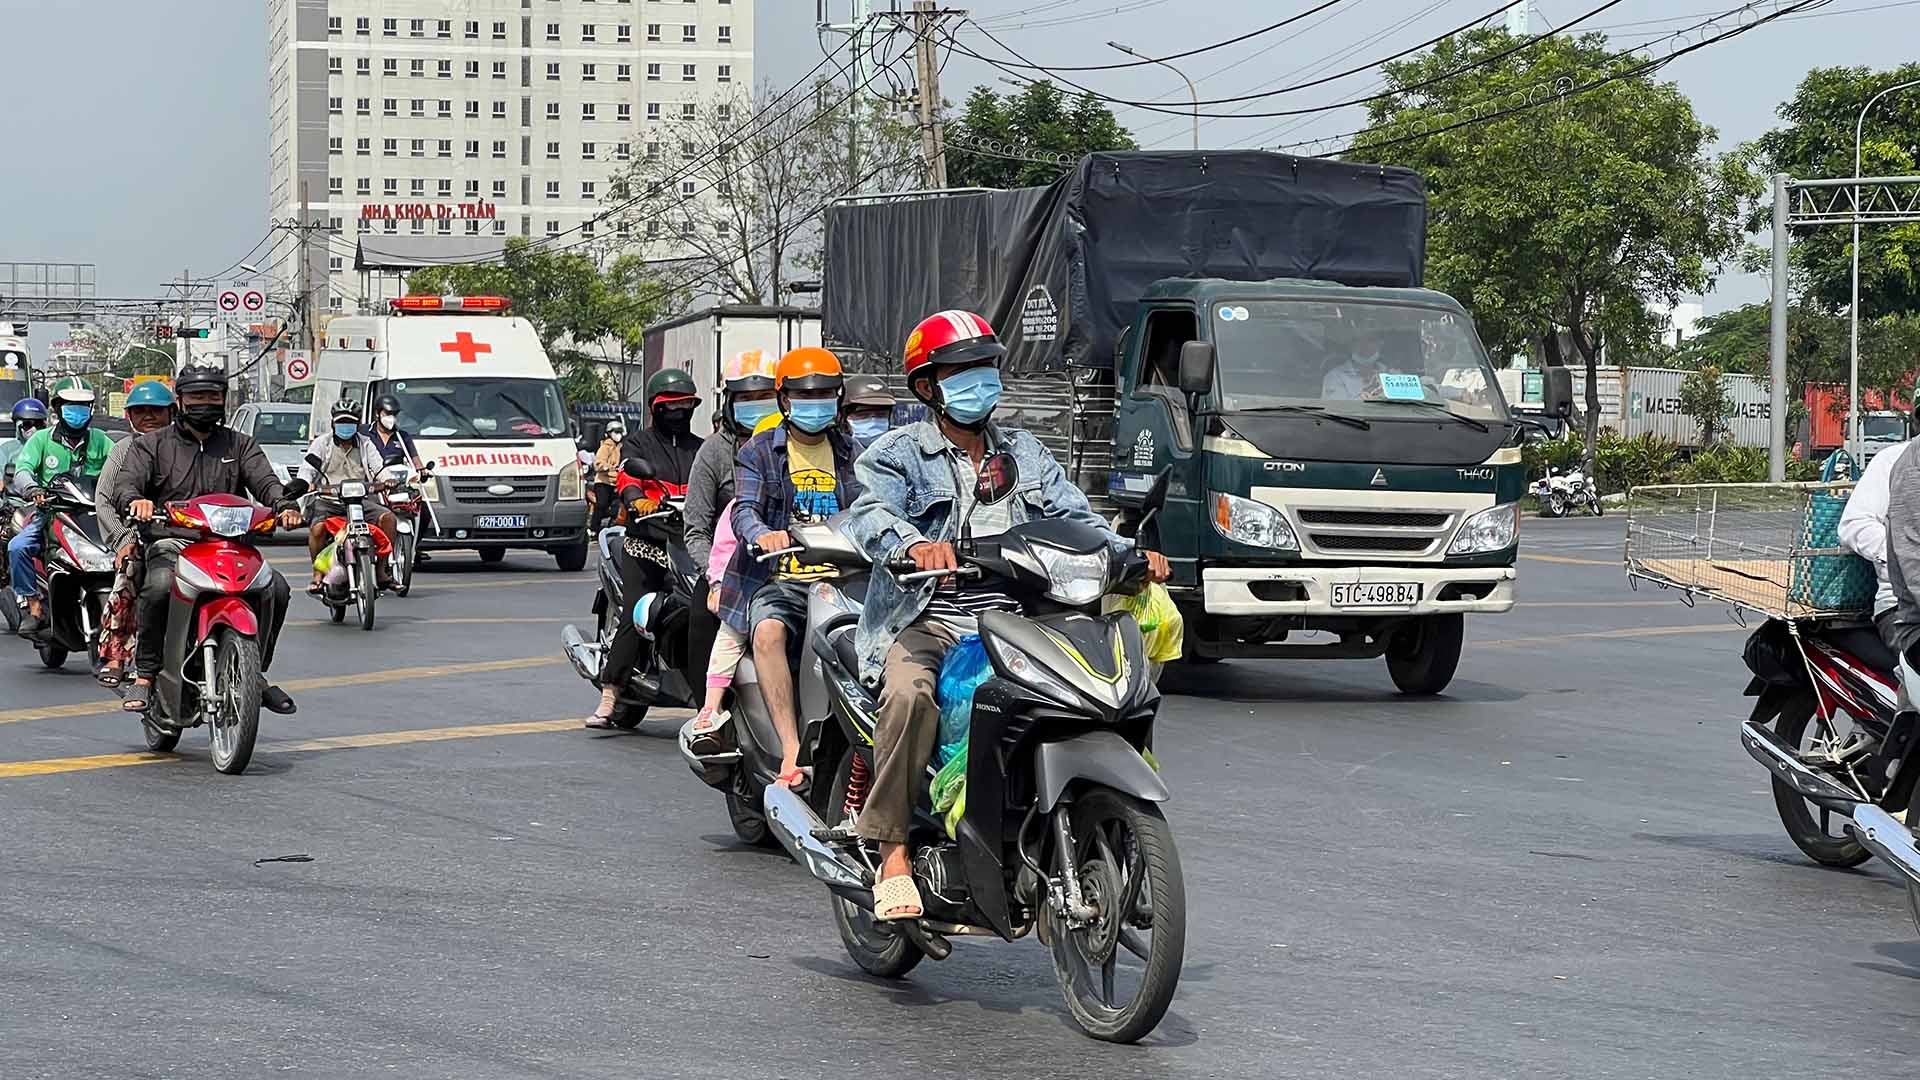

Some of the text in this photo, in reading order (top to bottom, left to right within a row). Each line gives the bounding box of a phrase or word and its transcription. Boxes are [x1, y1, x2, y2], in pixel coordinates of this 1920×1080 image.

[395, 204, 432, 219] KHOA
[437, 204, 456, 218] Dr.
[1456, 468, 1494, 481] THACO
[1334, 585, 1414, 603] 51C-498.84
[975, 702, 1002, 713] HONDA
